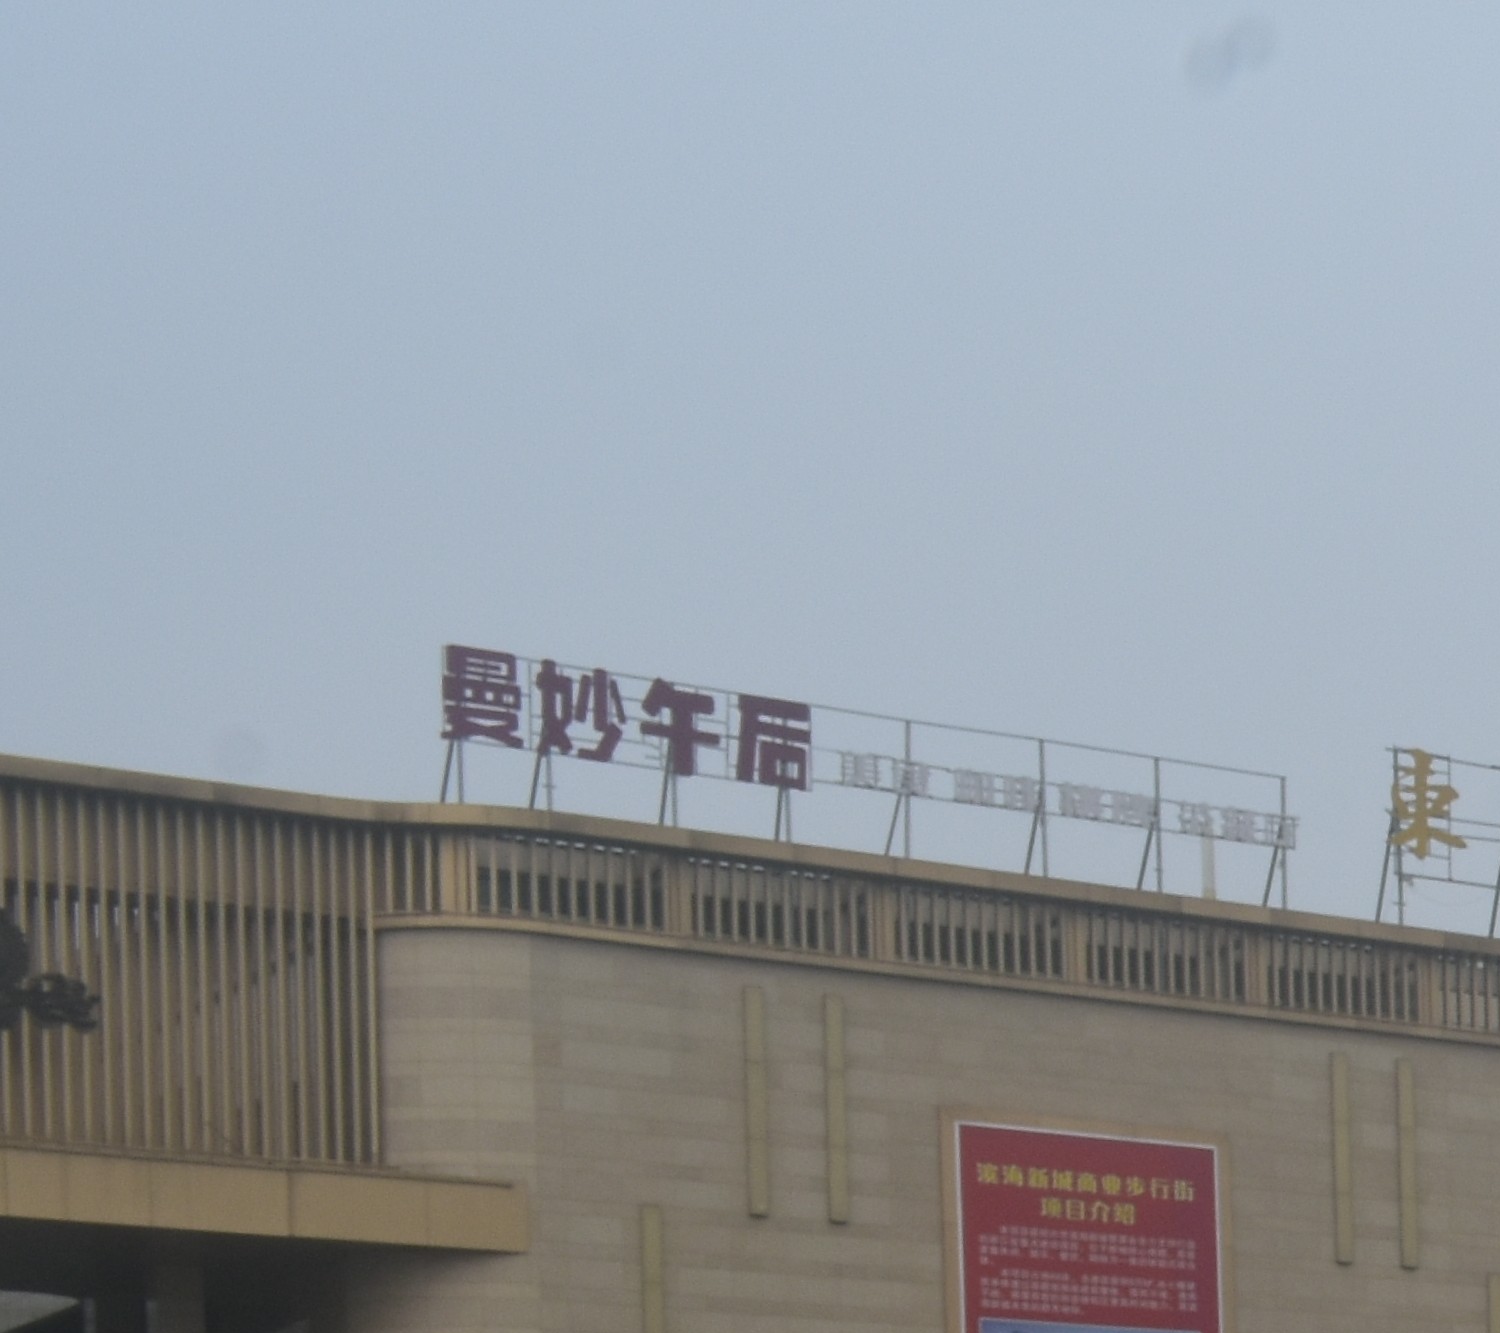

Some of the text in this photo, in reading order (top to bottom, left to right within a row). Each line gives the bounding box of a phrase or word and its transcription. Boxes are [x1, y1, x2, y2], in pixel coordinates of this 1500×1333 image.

[441, 644, 811, 791] 曼妙午后
[1040, 1197, 1137, 1226] 项目介绍
